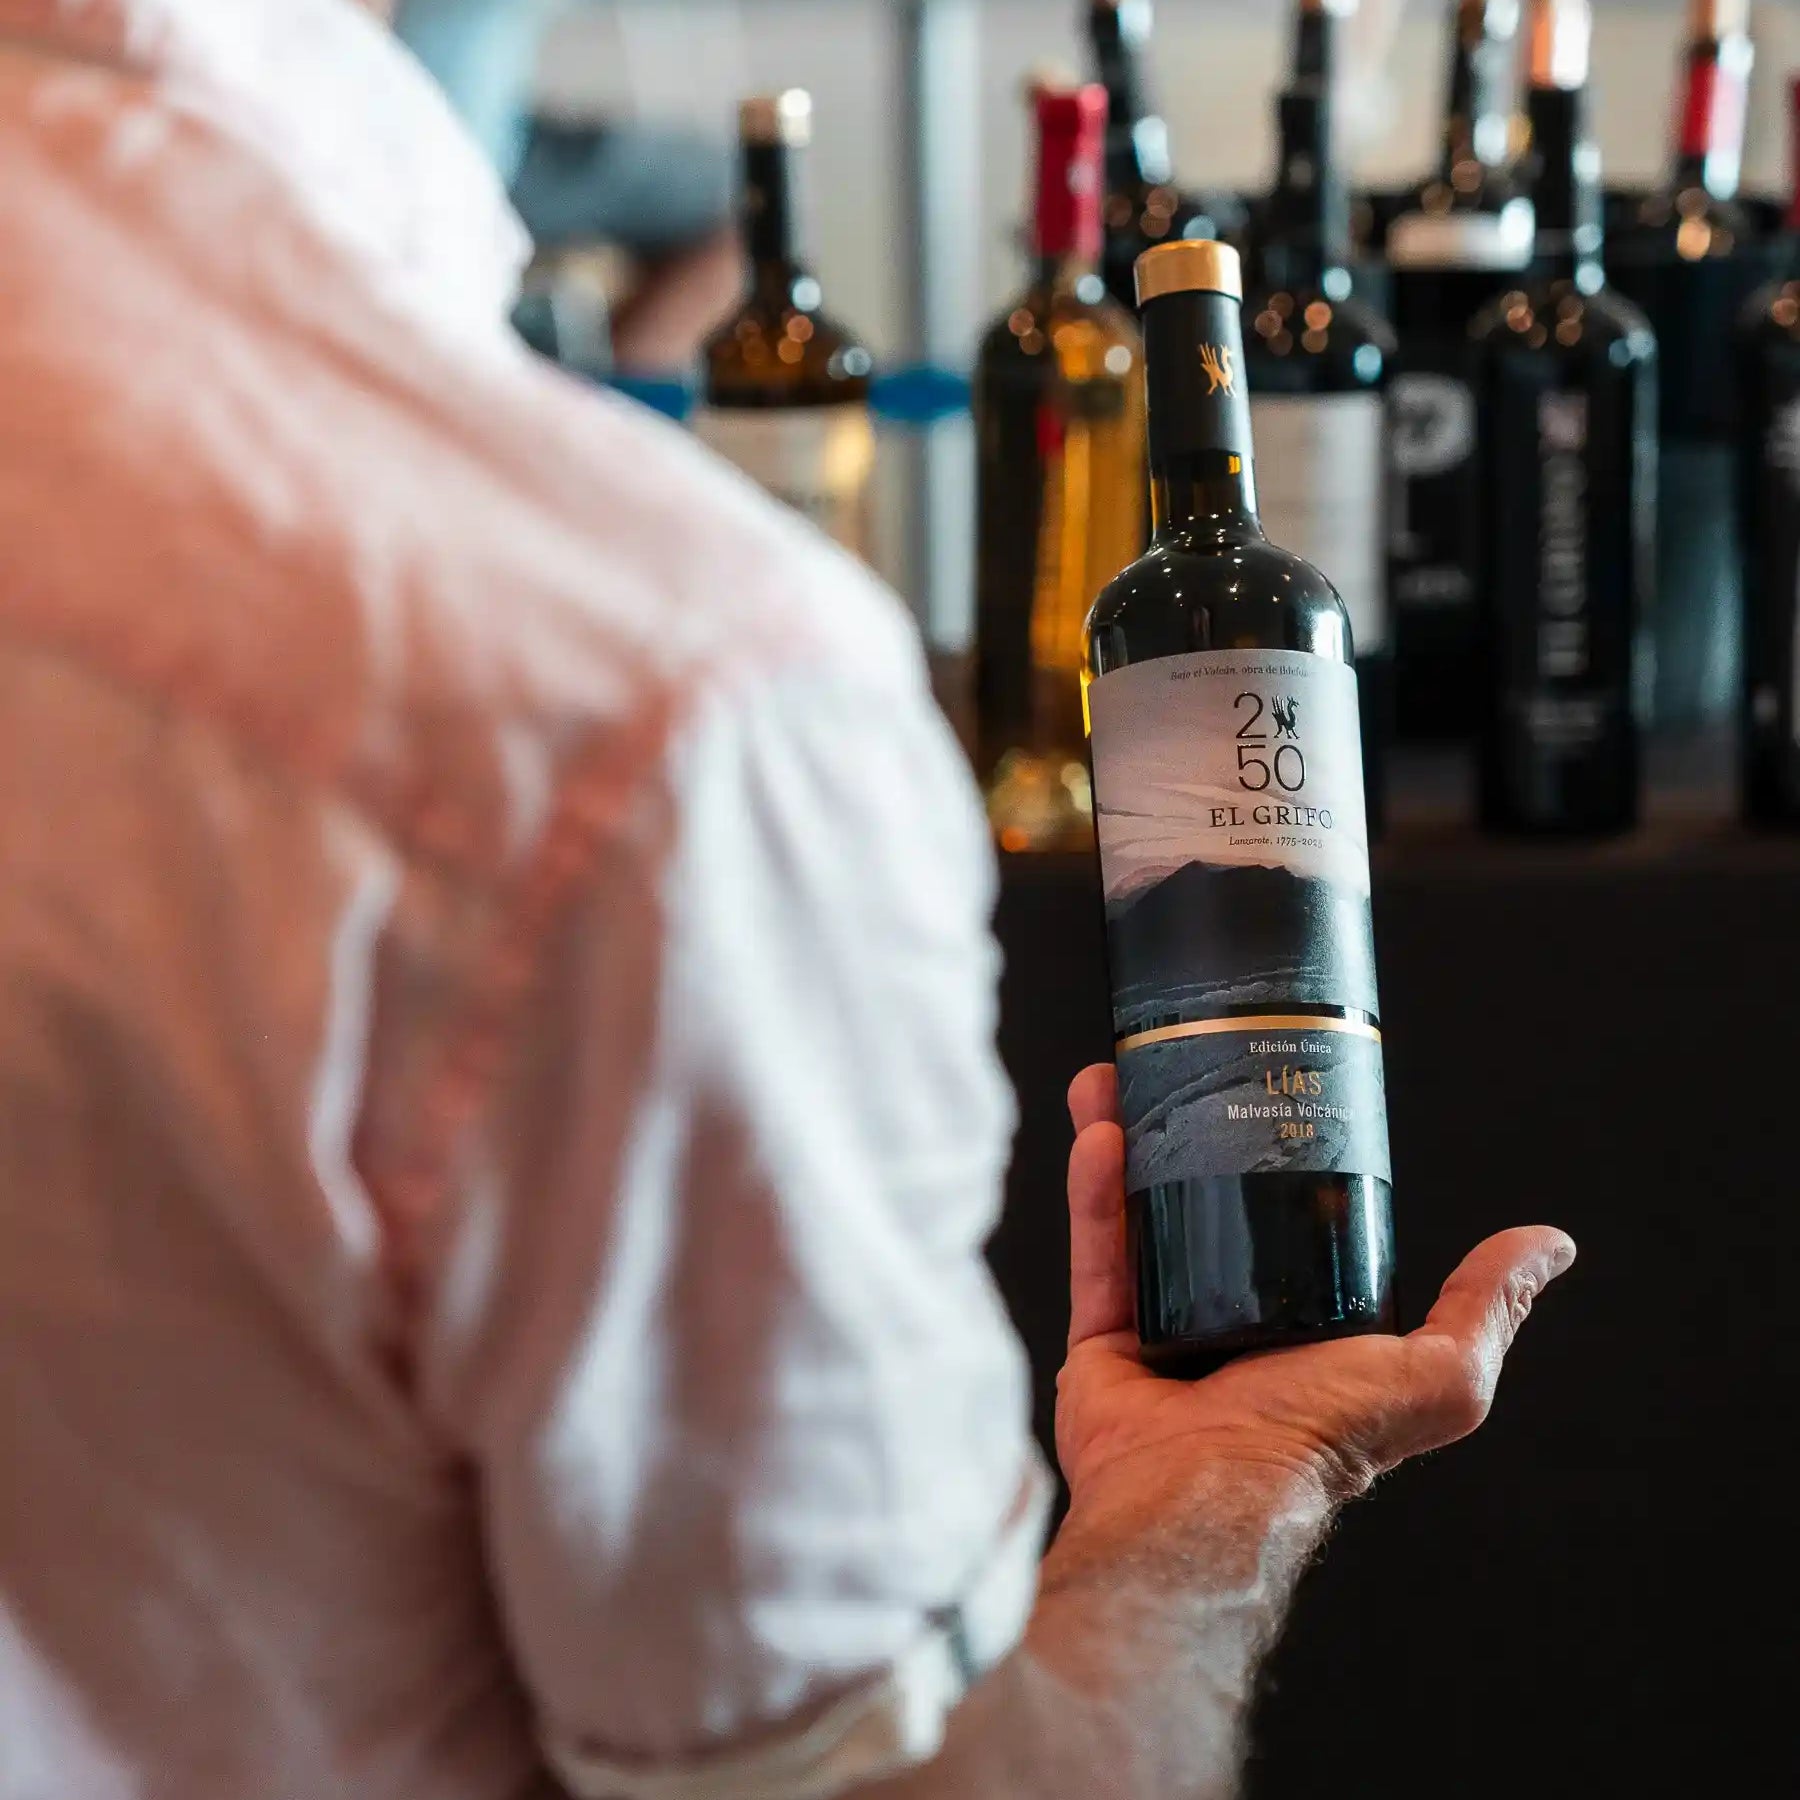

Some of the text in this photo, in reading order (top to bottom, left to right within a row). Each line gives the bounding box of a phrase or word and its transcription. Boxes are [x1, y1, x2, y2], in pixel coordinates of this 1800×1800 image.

[1241, 664, 1264, 674] obra
[1265, 664, 1277, 674] de
[1233, 691, 1267, 739] 2
[1236, 743, 1306, 792] 50
[1208, 805, 1333, 829] EL GRIFO
[1229, 836, 1273, 846] Lanzarote,
[1249, 1038, 1332, 1054] Edición Única
[1265, 1064, 1322, 1096] LÍAS
[1227, 1102, 1292, 1120] Malvasía
[1279, 1123, 1314, 1139] 2018
